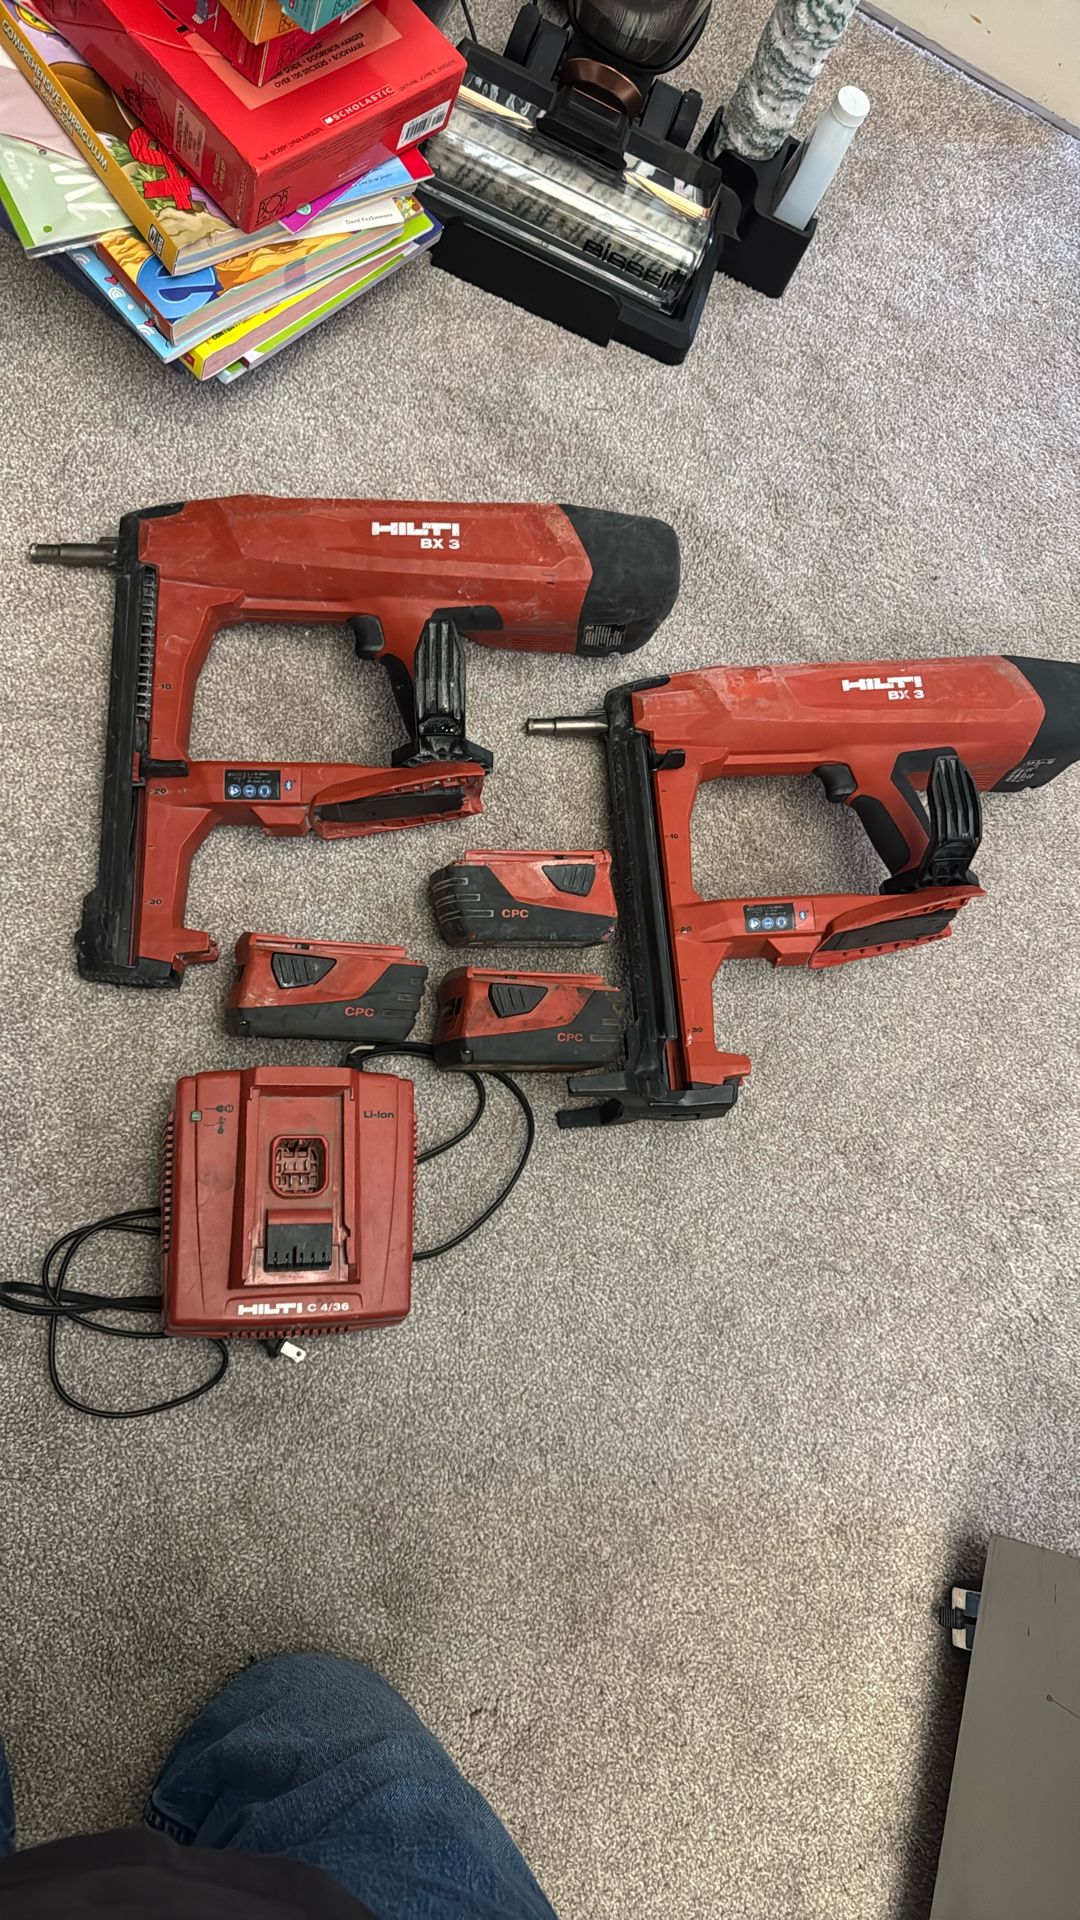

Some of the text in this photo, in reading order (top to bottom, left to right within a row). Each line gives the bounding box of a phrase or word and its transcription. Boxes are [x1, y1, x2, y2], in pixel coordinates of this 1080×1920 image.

[274, 77, 291, 88] OVER
[302, 60, 329, 76] STICKERS
[2, 20, 62, 104] COMPREHENSIVE
[61, 102, 108, 172] CURRICULUM
[332, 87, 394, 121] SCHOLASTIC
[371, 522, 460, 536] HILTI
[420, 538, 460, 549] BX 3
[842, 676, 923, 691] HILTI
[888, 689, 925, 700] BX 3
[502, 909, 529, 919] CPC
[344, 1007, 375, 1017] CPC
[557, 1033, 584, 1042] CPC
[363, 1110, 395, 1120] Li-Ion
[238, 1302, 350, 1315] HILTI C 4/36
